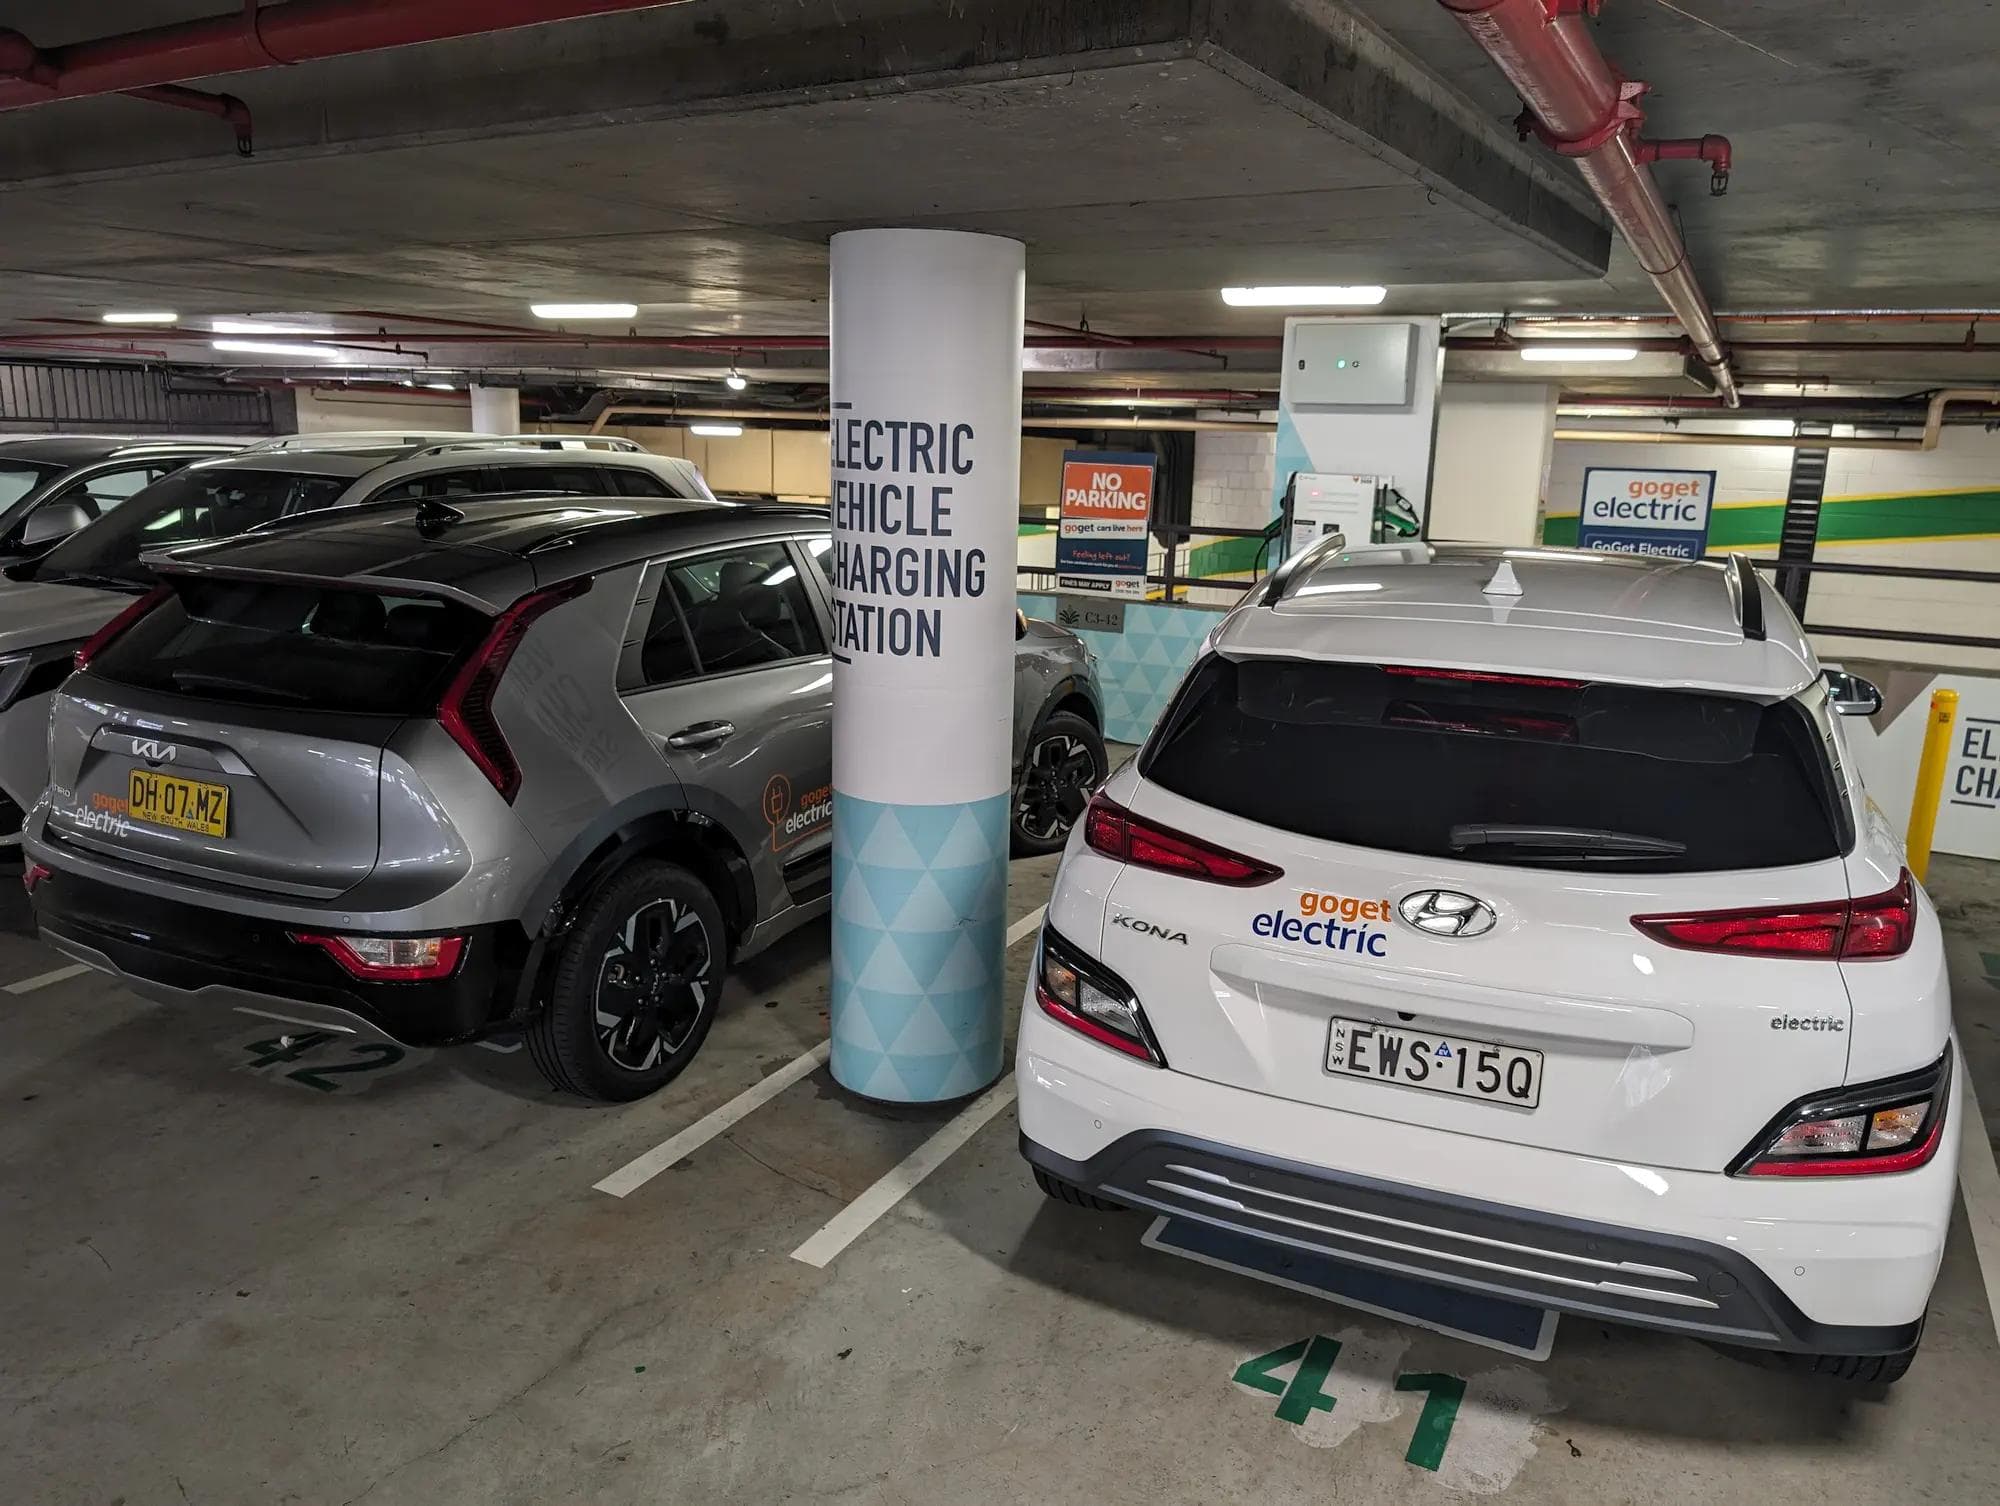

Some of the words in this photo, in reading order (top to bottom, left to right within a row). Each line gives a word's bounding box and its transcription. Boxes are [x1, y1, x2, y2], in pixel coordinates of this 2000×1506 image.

[1091, 472, 1122, 491] NO
[1628, 480, 1701, 499] goget
[1065, 488, 1147, 511] PARKING
[1593, 496, 1697, 521] electric
[1064, 523, 1095, 534] goget
[1097, 524, 1112, 532] cars
[1113, 524, 1126, 532] live
[1126, 524, 1143, 533] here
[1592, 540, 1635, 553] GoGet
[1639, 542, 1689, 557] Electric
[1115, 579, 1140, 588] goget
[1962, 727, 2000, 761] EL
[75, 804, 130, 838] electric
[142, 811, 157, 824] NEW
[785, 799, 832, 834] electric
[1300, 892, 1392, 923] goget
[1111, 913, 1189, 945] KONA
[1252, 909, 1387, 957] electric
[1770, 1014, 1844, 1032] electric
[243, 1031, 406, 1093] 42
[1231, 1334, 1468, 1472] 41
